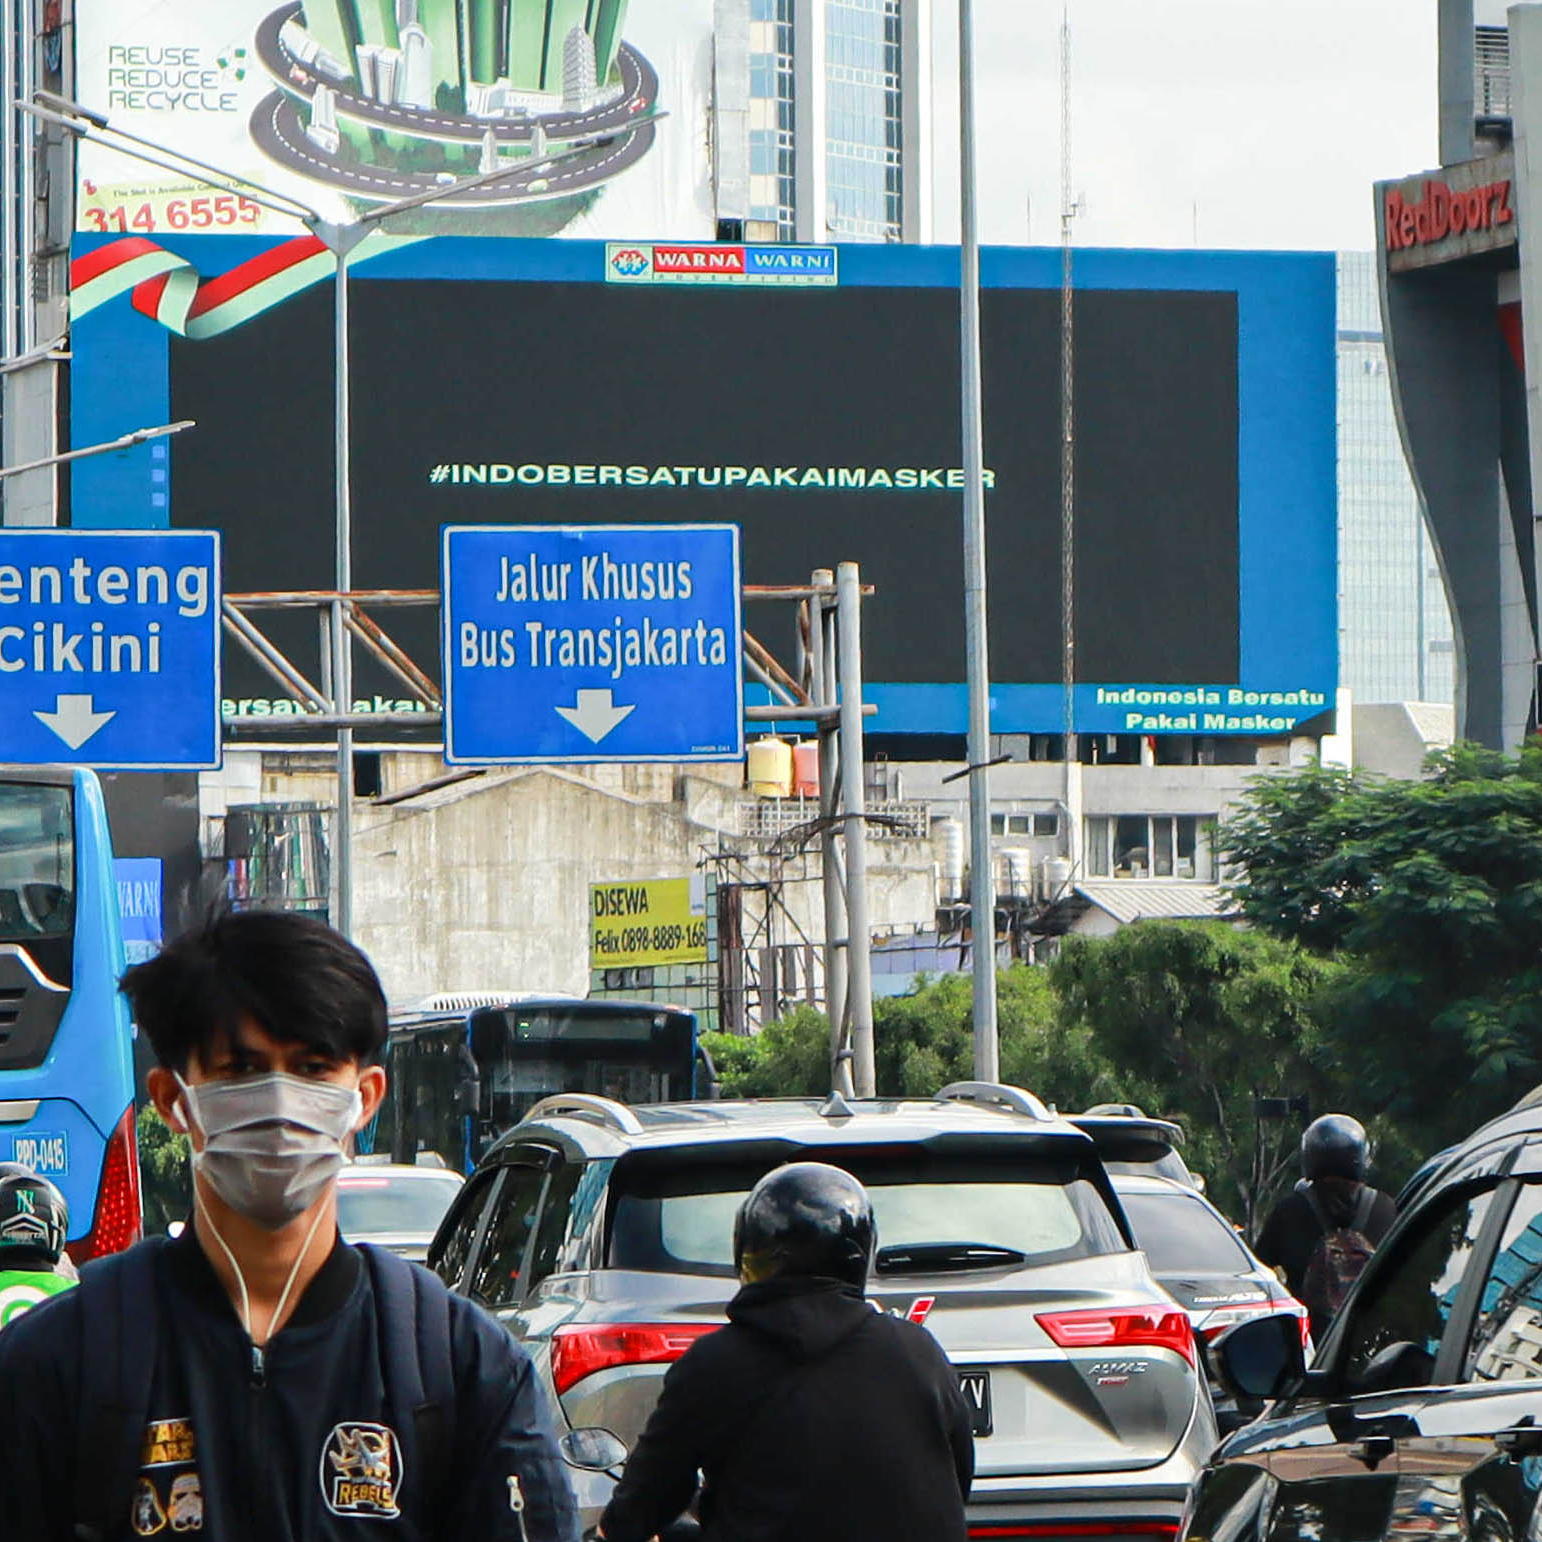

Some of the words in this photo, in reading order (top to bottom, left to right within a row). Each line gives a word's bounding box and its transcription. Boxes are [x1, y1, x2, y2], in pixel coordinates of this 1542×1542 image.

[108, 45, 201, 67] REUSE
[108, 68, 218, 90] REDUCE
[108, 90, 238, 112] RECYCLE
[166, 195, 262, 230] 6555
[1385, 179, 1515, 251] RedDoorz
[656, 252, 742, 268] WARNA
[754, 253, 830, 268] WARNI
[428, 462, 996, 489] #INDOBERSATUPAKAIMASKER
[496, 553, 571, 602] Jalur
[581, 552, 693, 601] Khusus
[461, 622, 516, 668] Bus
[525, 616, 726, 679] Transjakarta
[1096, 687, 1221, 706] Indonesia
[1227, 687, 1325, 706] Bersatu
[1125, 712, 1197, 730] Pakai
[1203, 713, 1296, 731] Masker
[594, 887, 649, 917] DISEWA
[595, 928, 620, 953] Felix
[15, 1137, 65, 1172] PPD-0415
[339, 1482, 393, 1509] REBELS
